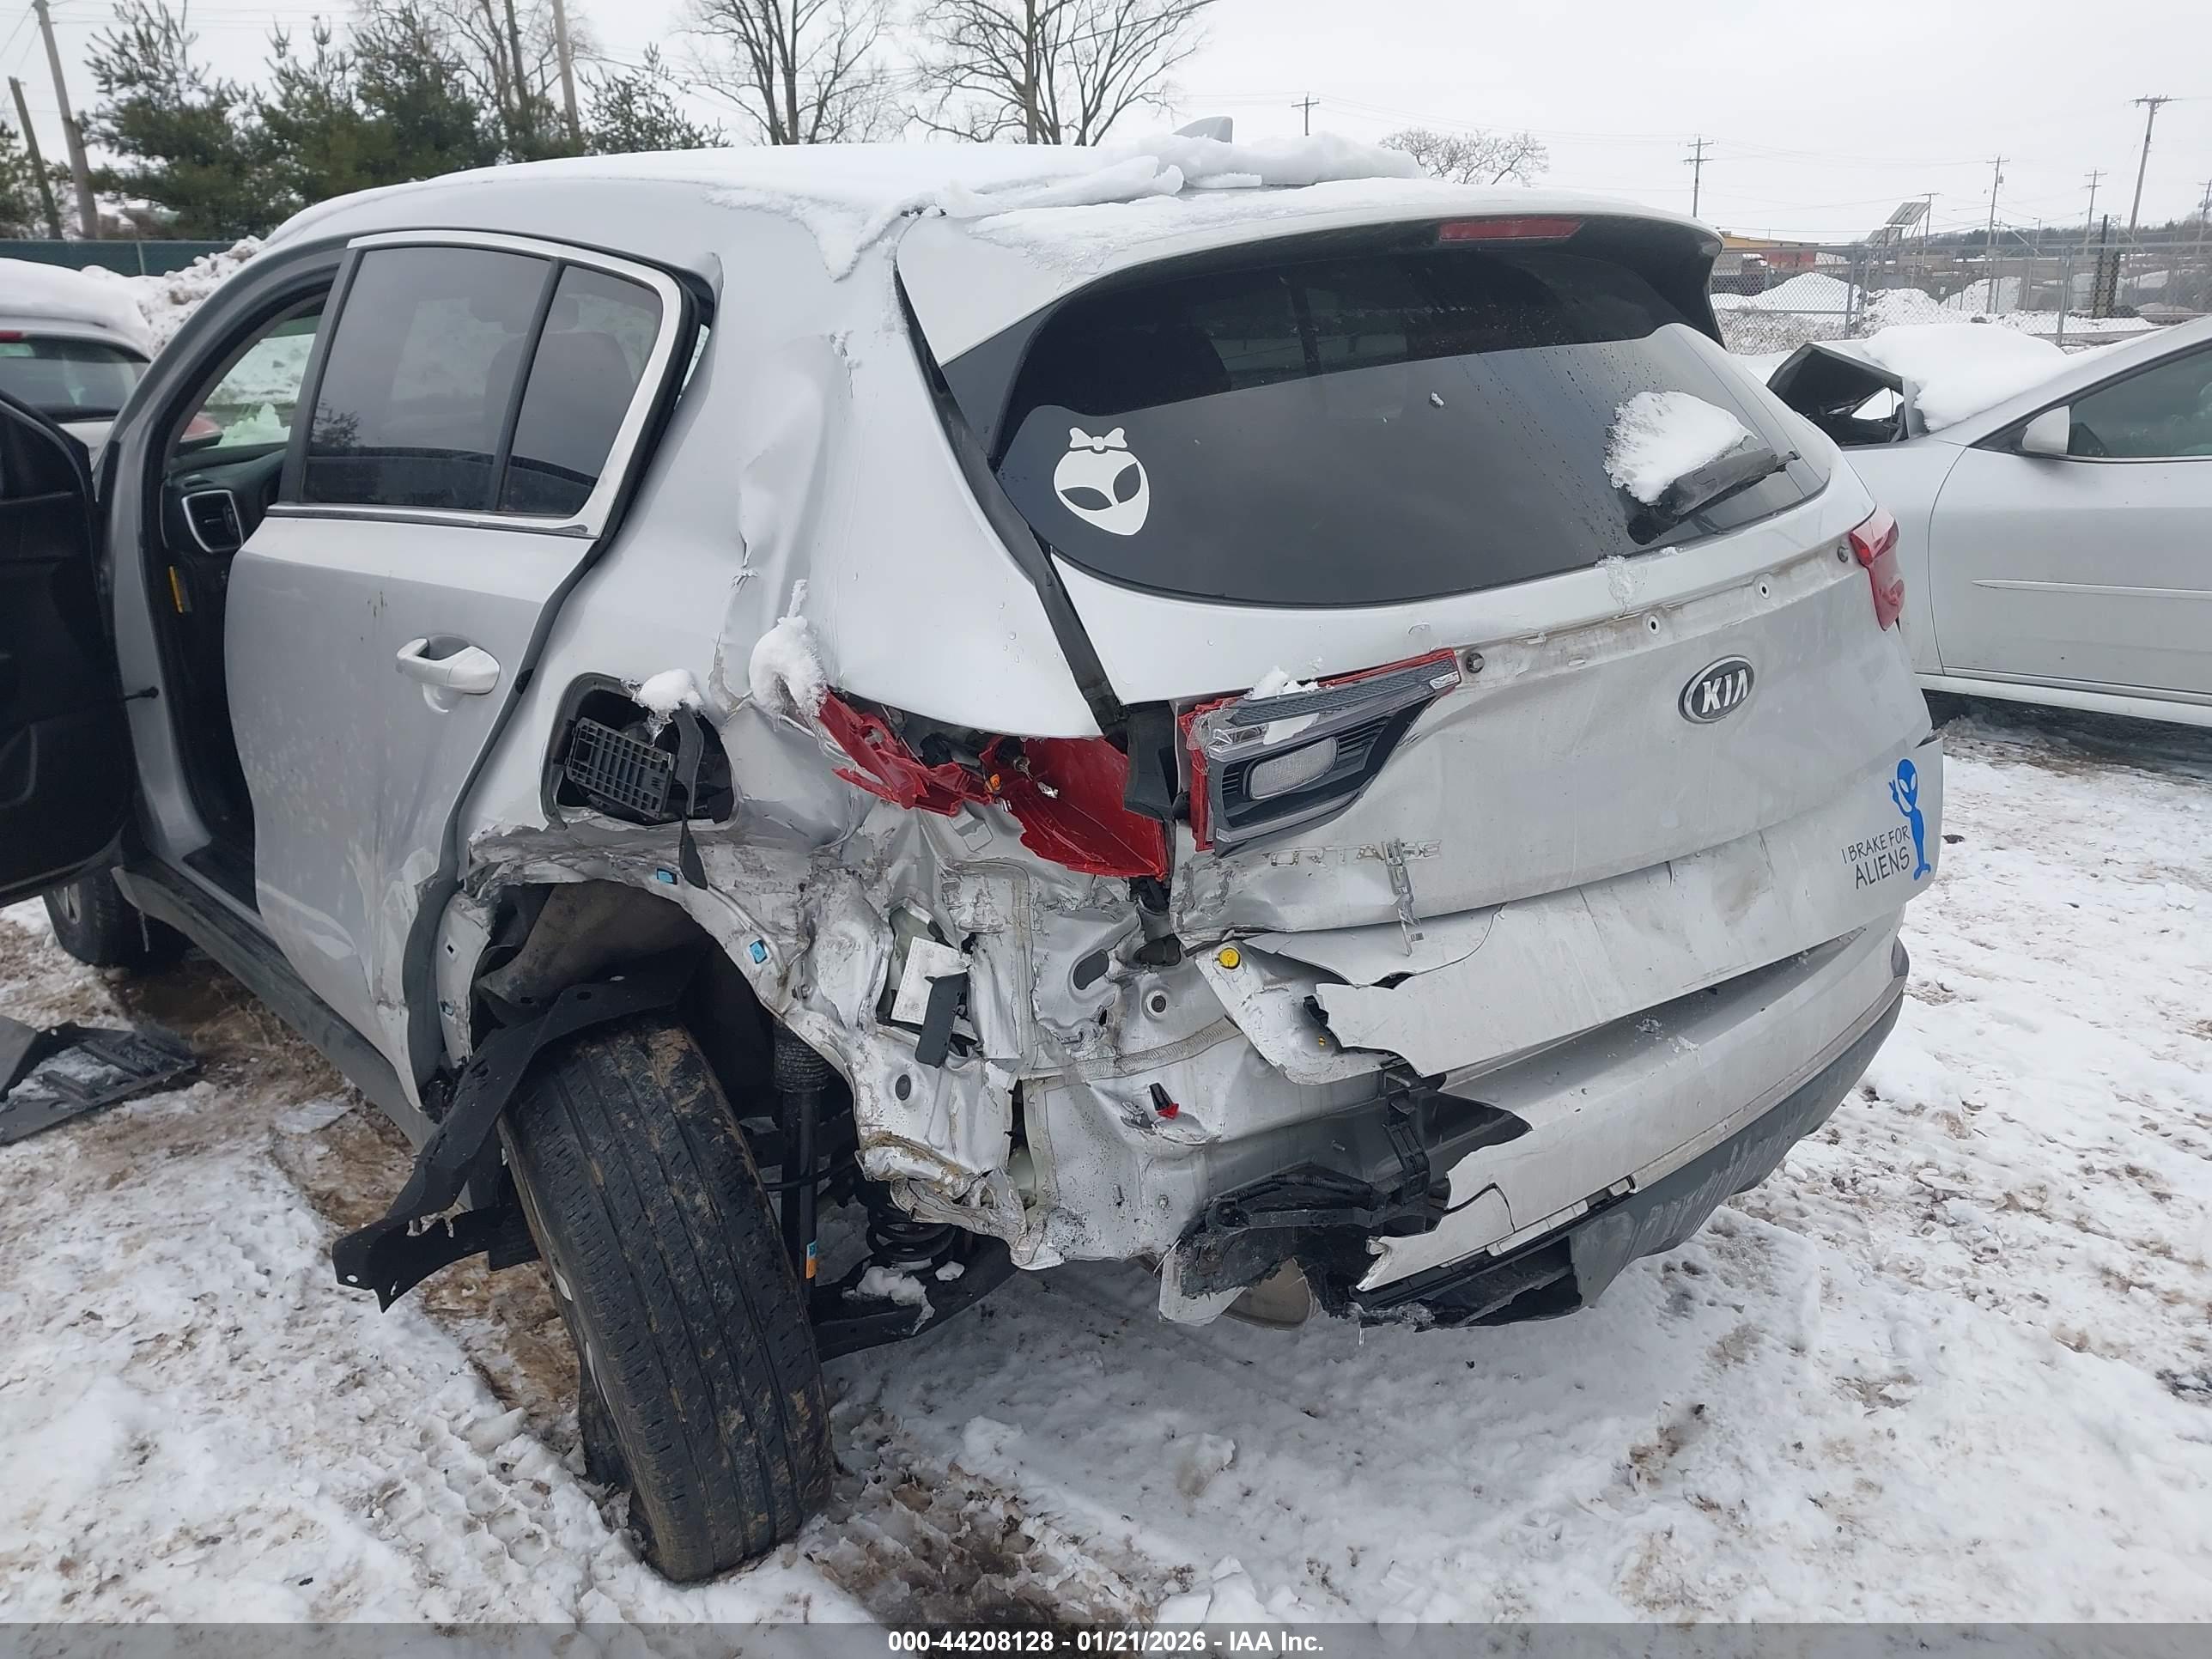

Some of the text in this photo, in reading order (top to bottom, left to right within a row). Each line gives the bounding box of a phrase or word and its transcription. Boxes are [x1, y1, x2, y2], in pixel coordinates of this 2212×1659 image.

[1702, 669, 1748, 714] KIA
[1841, 825, 1911, 865] I BRAKE FOR
[1856, 847, 1910, 890] ALIENS
